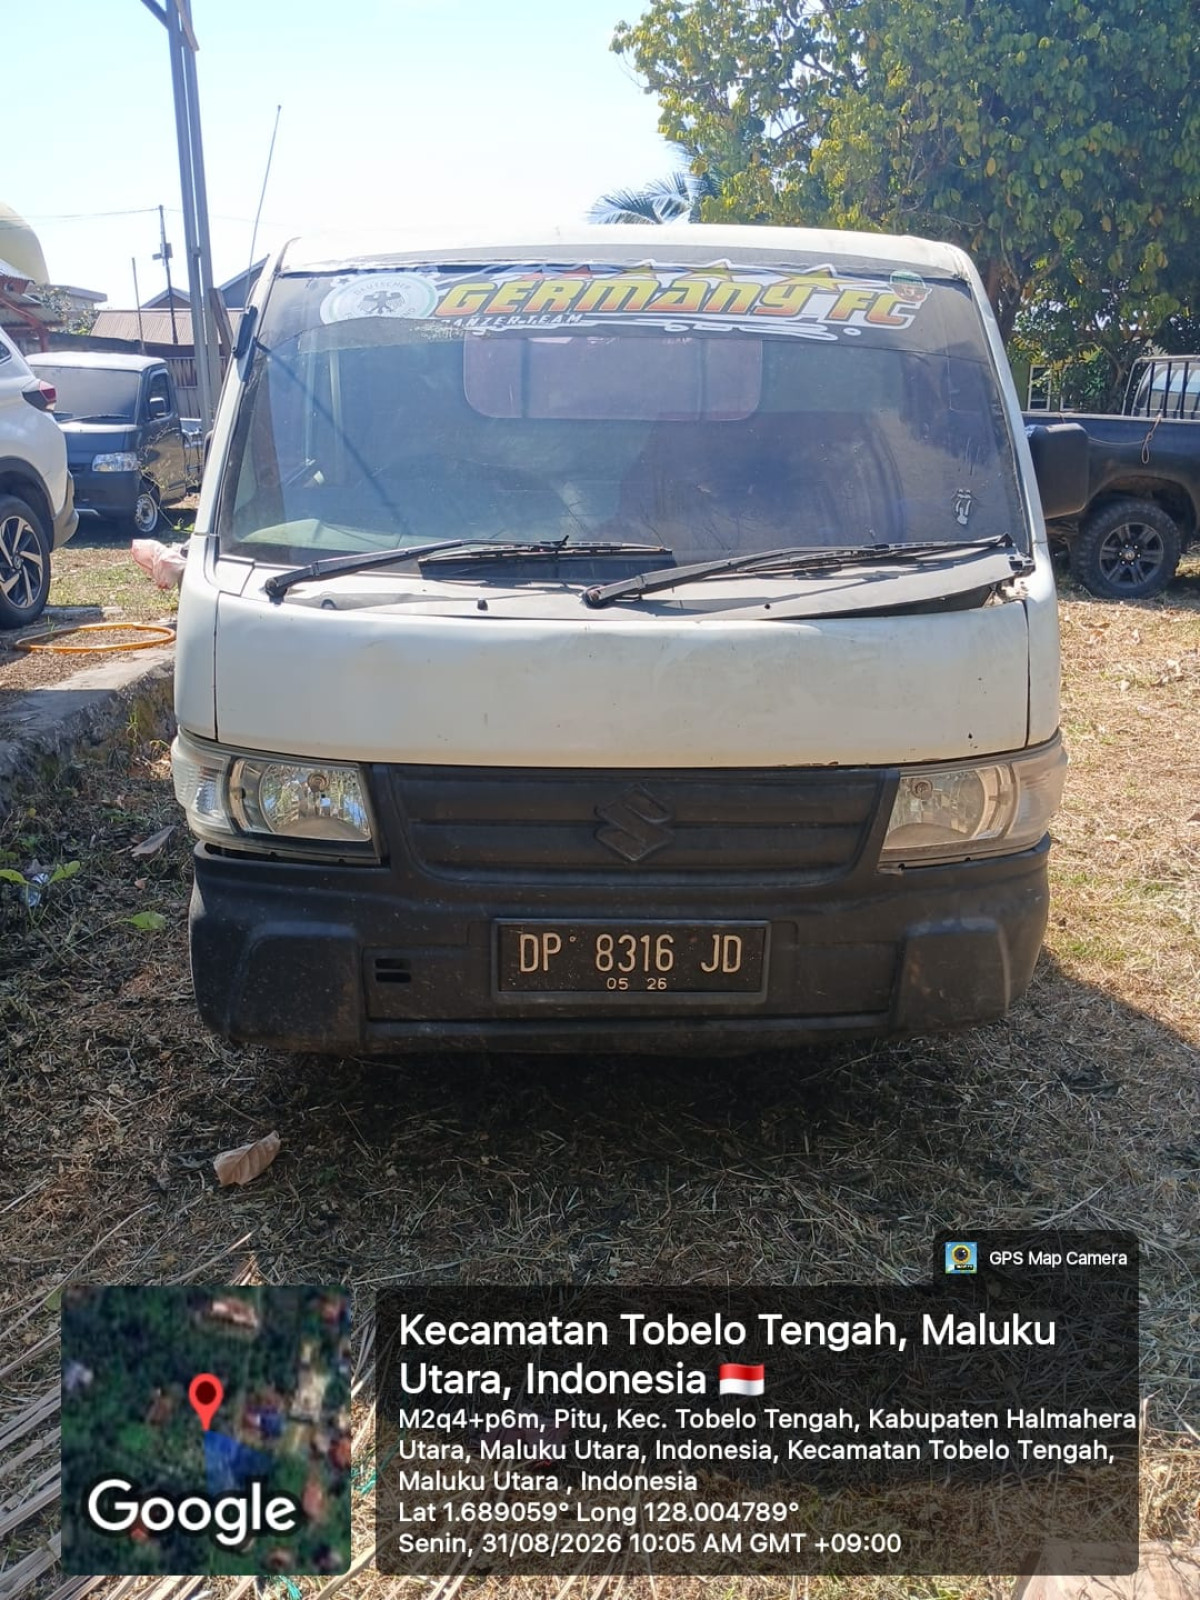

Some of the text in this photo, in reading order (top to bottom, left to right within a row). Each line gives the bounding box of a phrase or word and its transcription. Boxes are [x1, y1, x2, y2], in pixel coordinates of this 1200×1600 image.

[827, 289, 916, 324] FC
[519, 932, 742, 973] DP 8316 JD
[606, 977, 668, 991] 05 26
